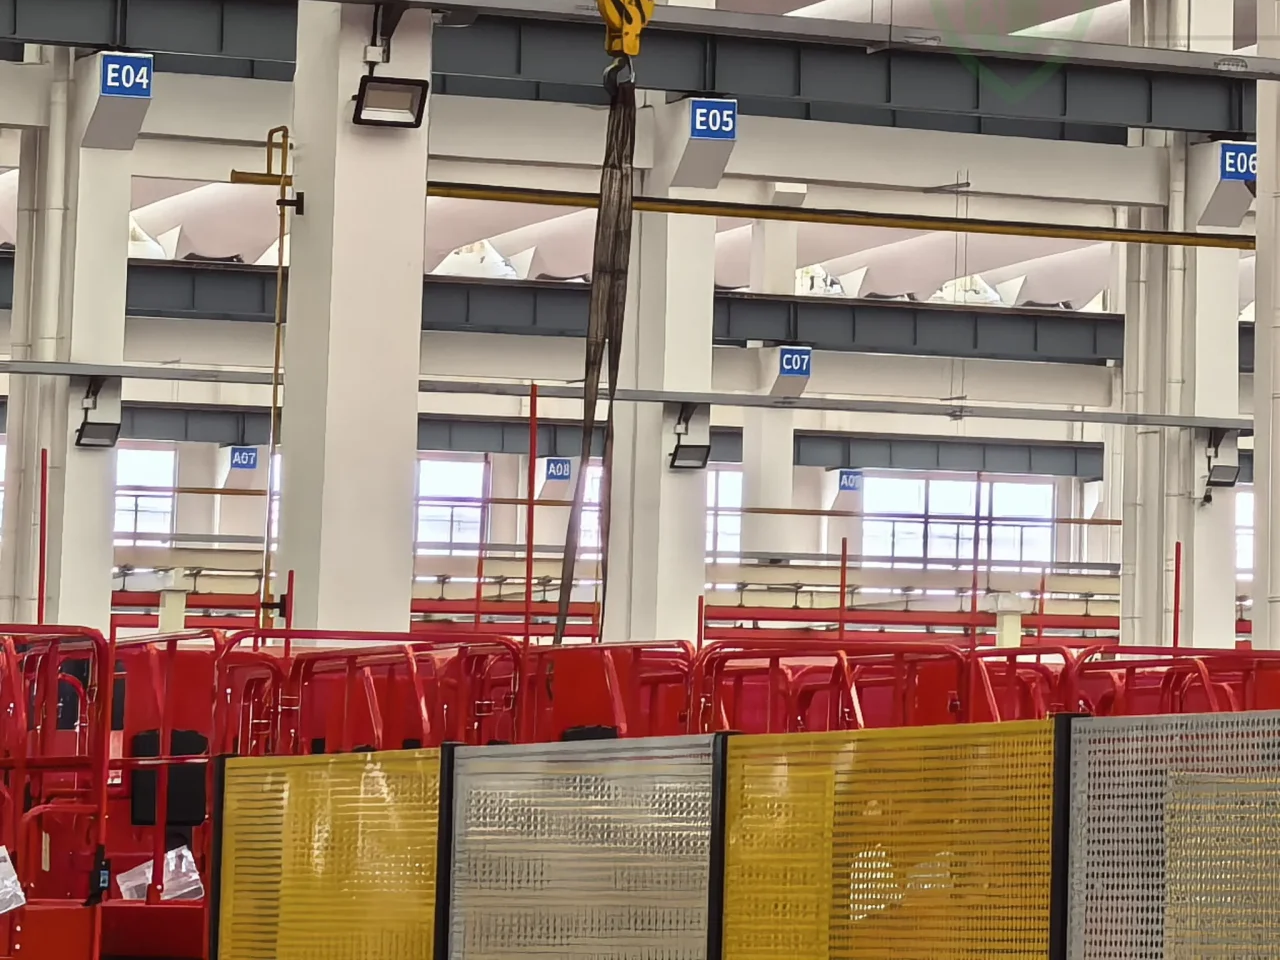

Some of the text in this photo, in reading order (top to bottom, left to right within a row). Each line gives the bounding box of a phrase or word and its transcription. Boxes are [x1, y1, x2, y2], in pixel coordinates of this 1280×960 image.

[106, 63, 149, 89] E04
[695, 108, 734, 132] E05
[1225, 151, 1257, 173] E06
[782, 354, 810, 371] C07
[232, 452, 256, 465] A07
